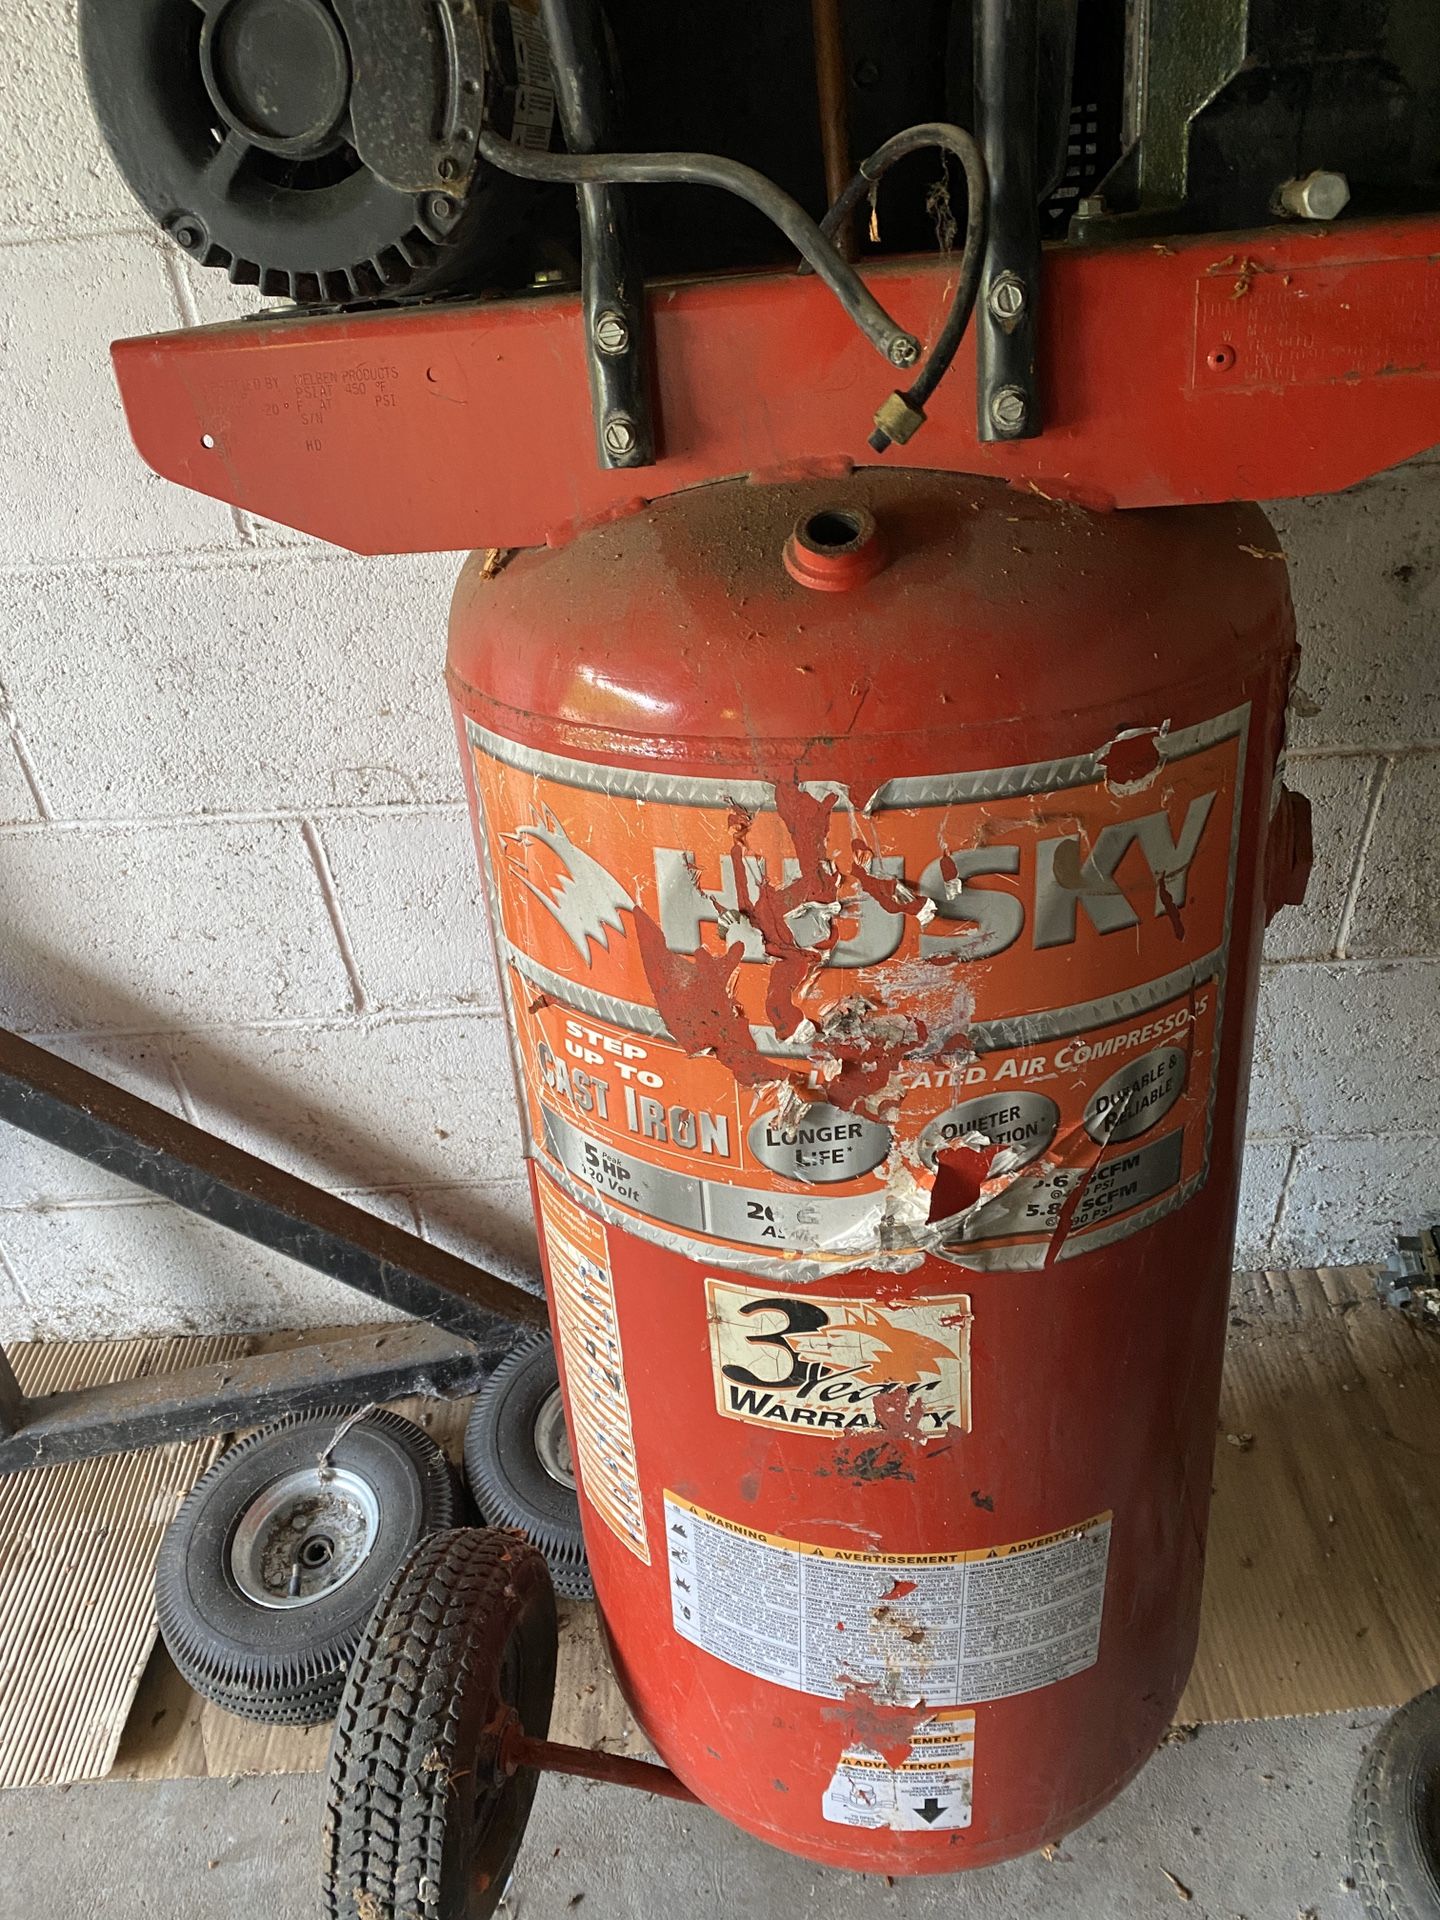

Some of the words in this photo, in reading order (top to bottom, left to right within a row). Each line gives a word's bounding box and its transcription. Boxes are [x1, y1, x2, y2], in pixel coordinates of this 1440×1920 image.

[342, 366, 399, 382] PRODUCTS
[375, 395, 397, 408] PSI
[654, 791, 1218, 968] HUSKY
[565, 1019, 648, 1060] STEP
[565, 1039, 604, 1065] UP
[614, 1061, 664, 1088] TO
[994, 1057, 1047, 1082] AIR
[537, 1040, 609, 1120] CAST
[624, 1085, 729, 1157] IRON
[1096, 1062, 1165, 1115] DURABLE
[1168, 1054, 1177, 1069] &
[1104, 1077, 1172, 1132] RELIABLE
[766, 1123, 863, 1147] LONGER
[941, 1105, 1021, 1139] QUIETER
[585, 1141, 600, 1167] 5
[603, 1159, 631, 1181] HP
[602, 1151, 622, 1166] Peak
[608, 1177, 640, 1202] Volt
[1082, 1181, 1138, 1212] SCFM
[1094, 1179, 1114, 1194] PSI
[1092, 1204, 1113, 1219] PSI
[721, 1298, 829, 1388] 3
[796, 1362, 942, 1404] Year
[705, 1513, 768, 1542] WARNING
[834, 1551, 958, 1564] AVERTISSEMENT
